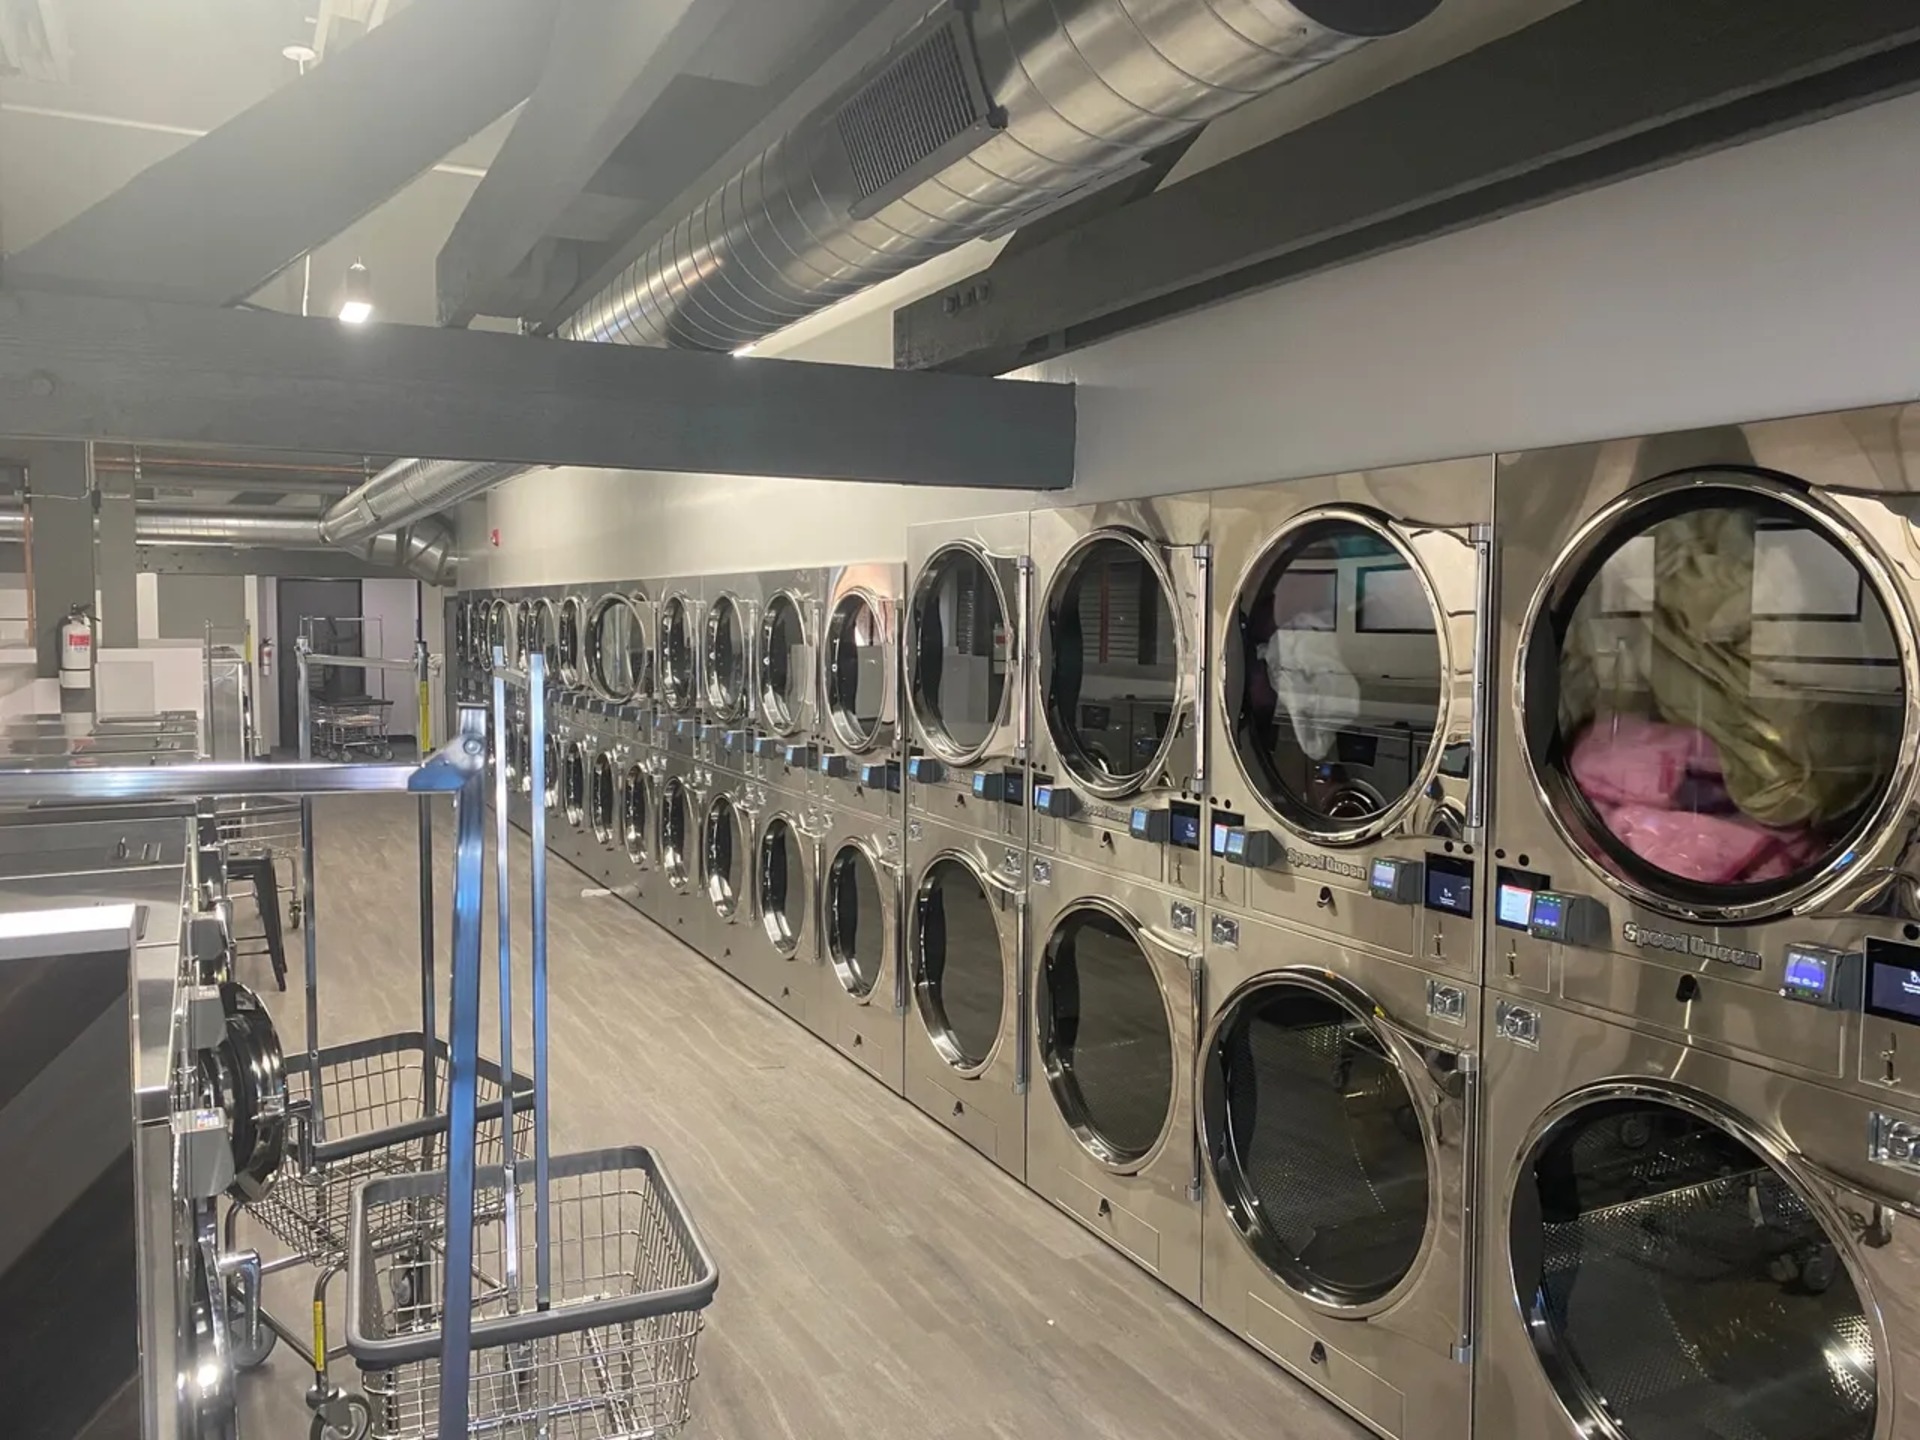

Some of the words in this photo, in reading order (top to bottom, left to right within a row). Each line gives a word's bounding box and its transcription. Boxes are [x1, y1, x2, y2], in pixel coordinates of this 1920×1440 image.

[1287, 847, 1326, 870] Speed
[1326, 857, 1367, 881] Queen
[1623, 921, 1689, 954] Speed
[1689, 935, 1762, 971] Queen
